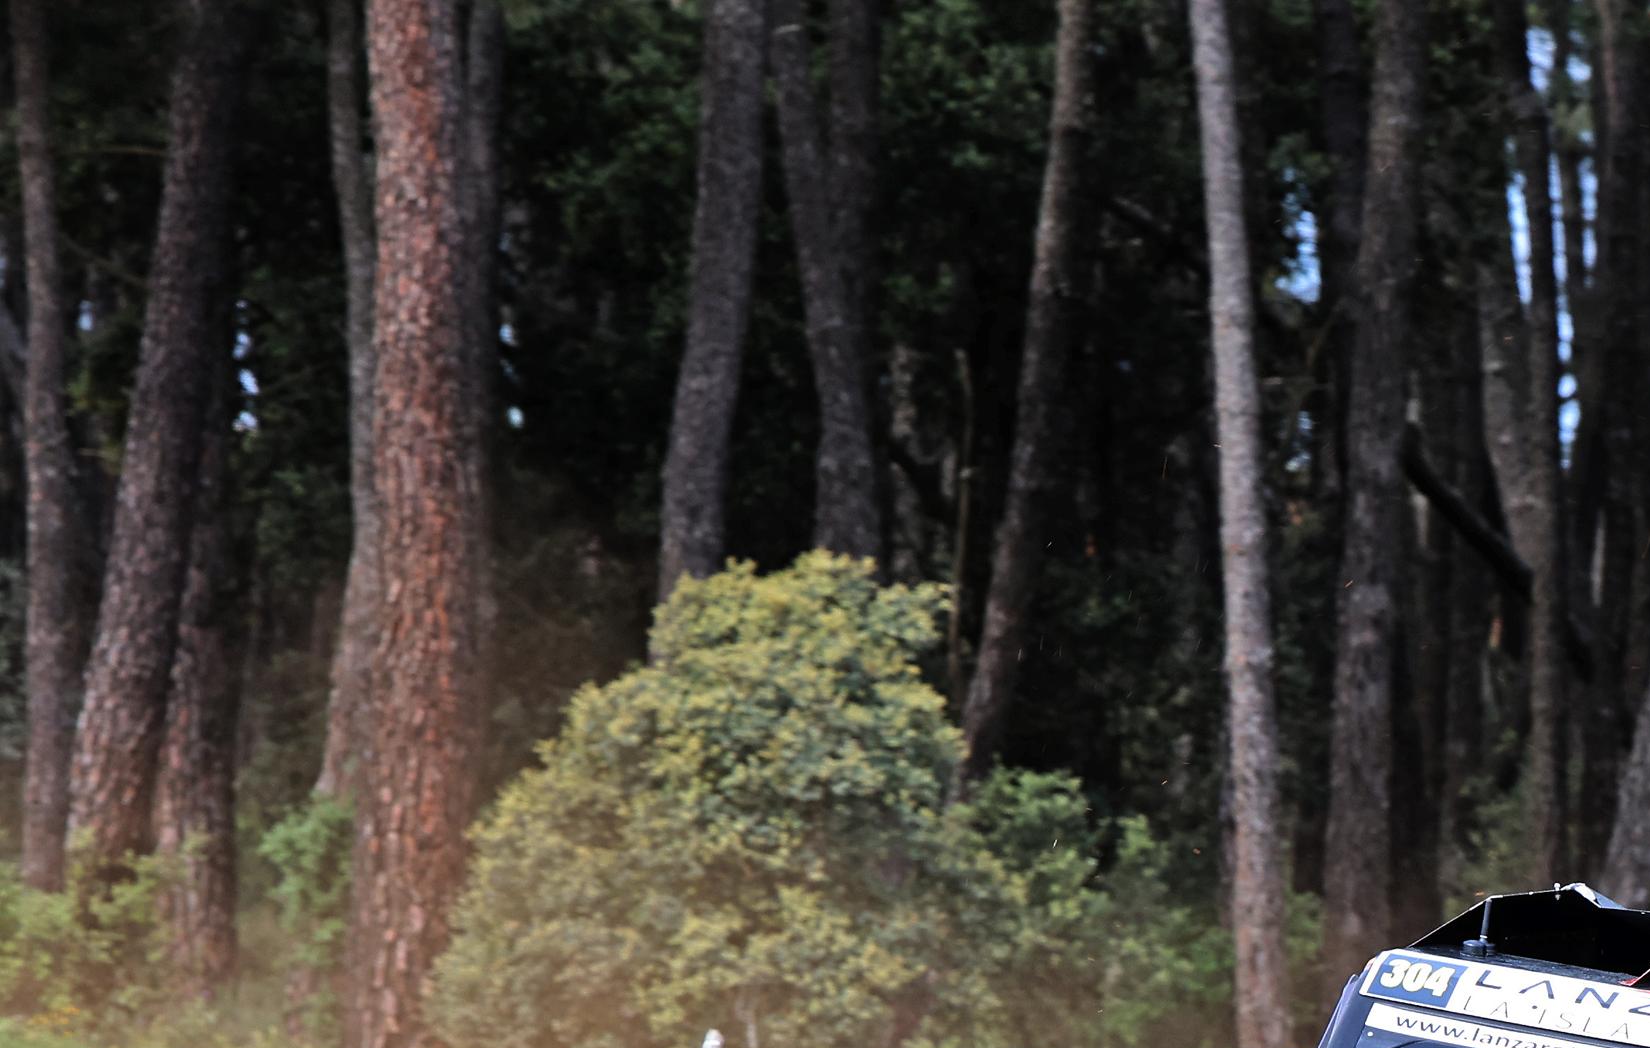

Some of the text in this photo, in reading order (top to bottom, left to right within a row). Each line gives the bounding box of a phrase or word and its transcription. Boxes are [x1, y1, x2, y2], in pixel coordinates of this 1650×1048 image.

[1379, 958, 1456, 997] 304
[1463, 995, 1510, 1020] LA
[1536, 1009, 1631, 1040] ISLA
